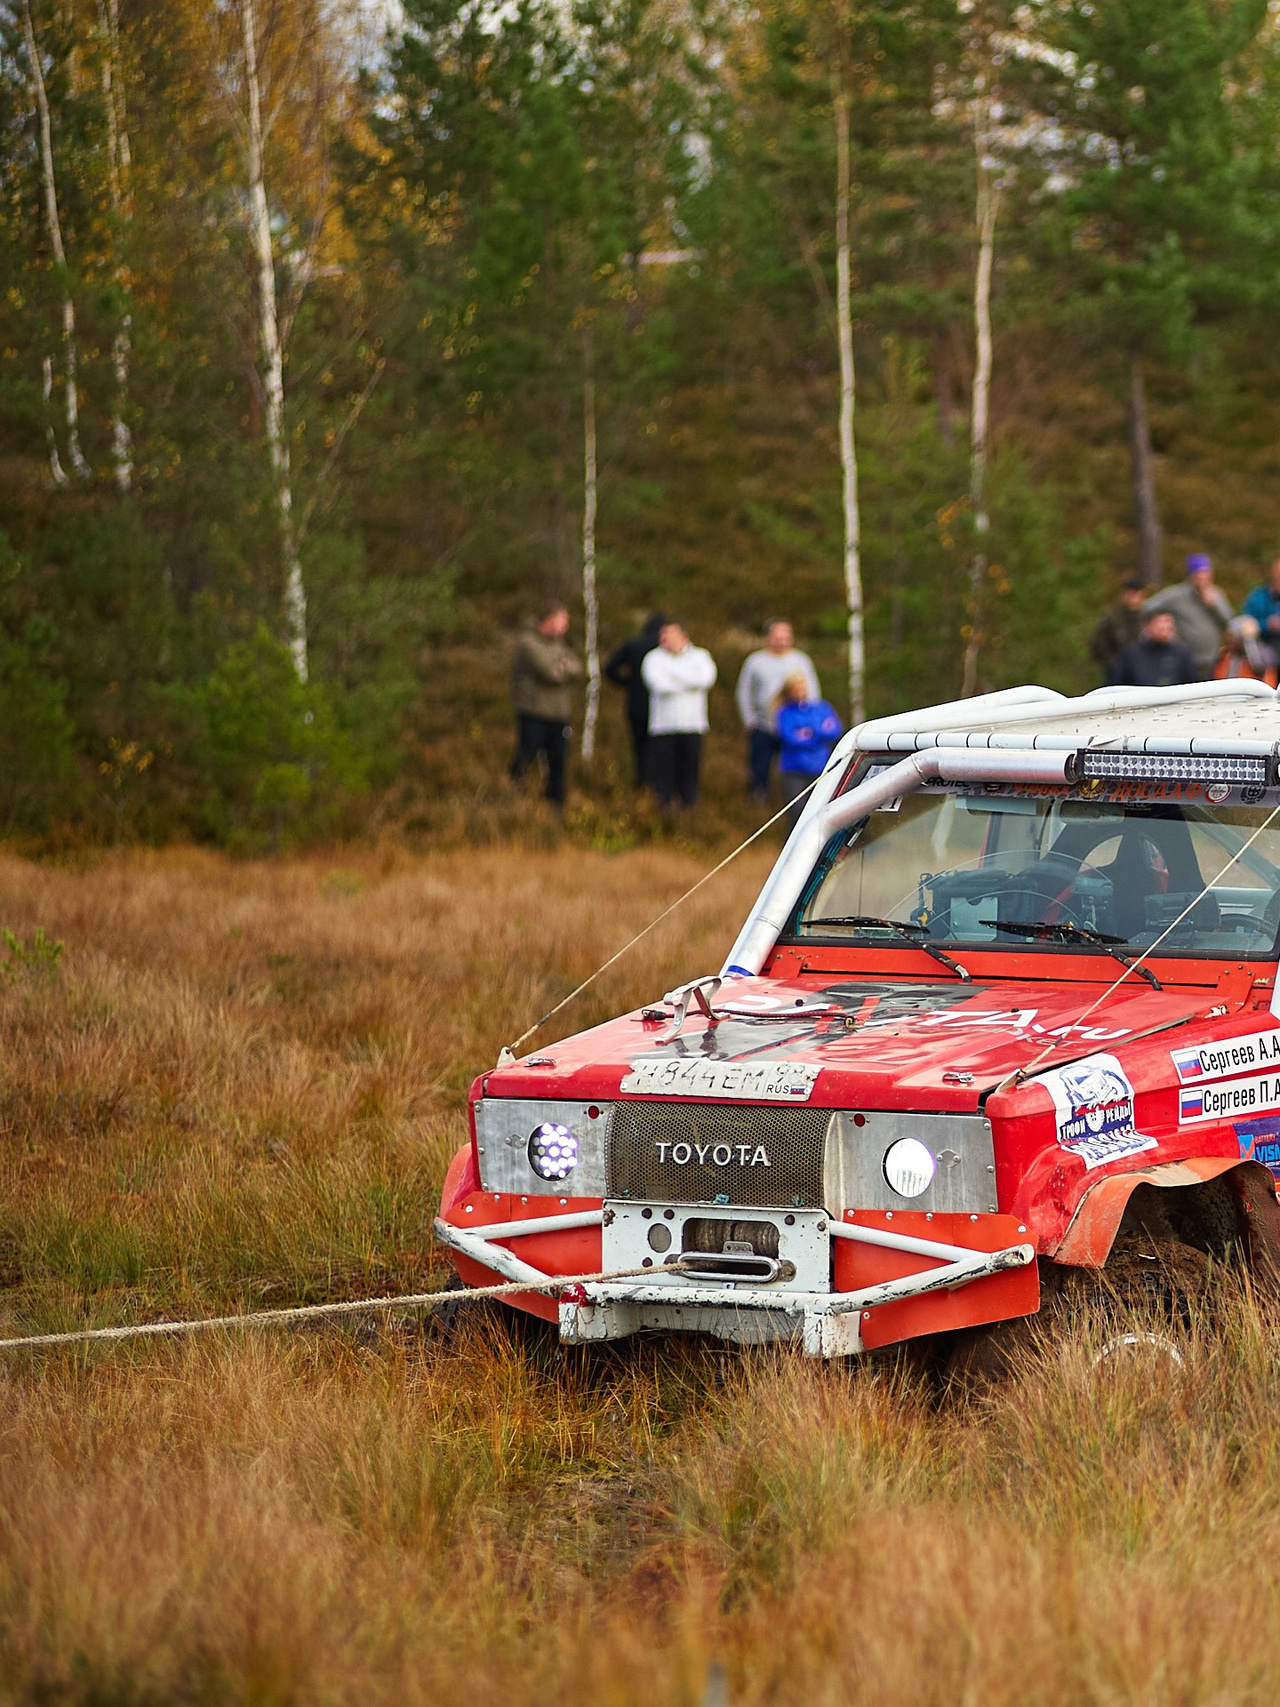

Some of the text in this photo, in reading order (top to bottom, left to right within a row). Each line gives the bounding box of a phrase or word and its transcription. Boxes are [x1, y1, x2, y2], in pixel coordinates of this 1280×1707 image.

[1199, 1045, 1255, 1074] Сергеев
[766, 1084, 790, 1094] RUS
[1203, 1088, 1256, 1116] Сергеев
[656, 1142, 771, 1167] TOYOTA
